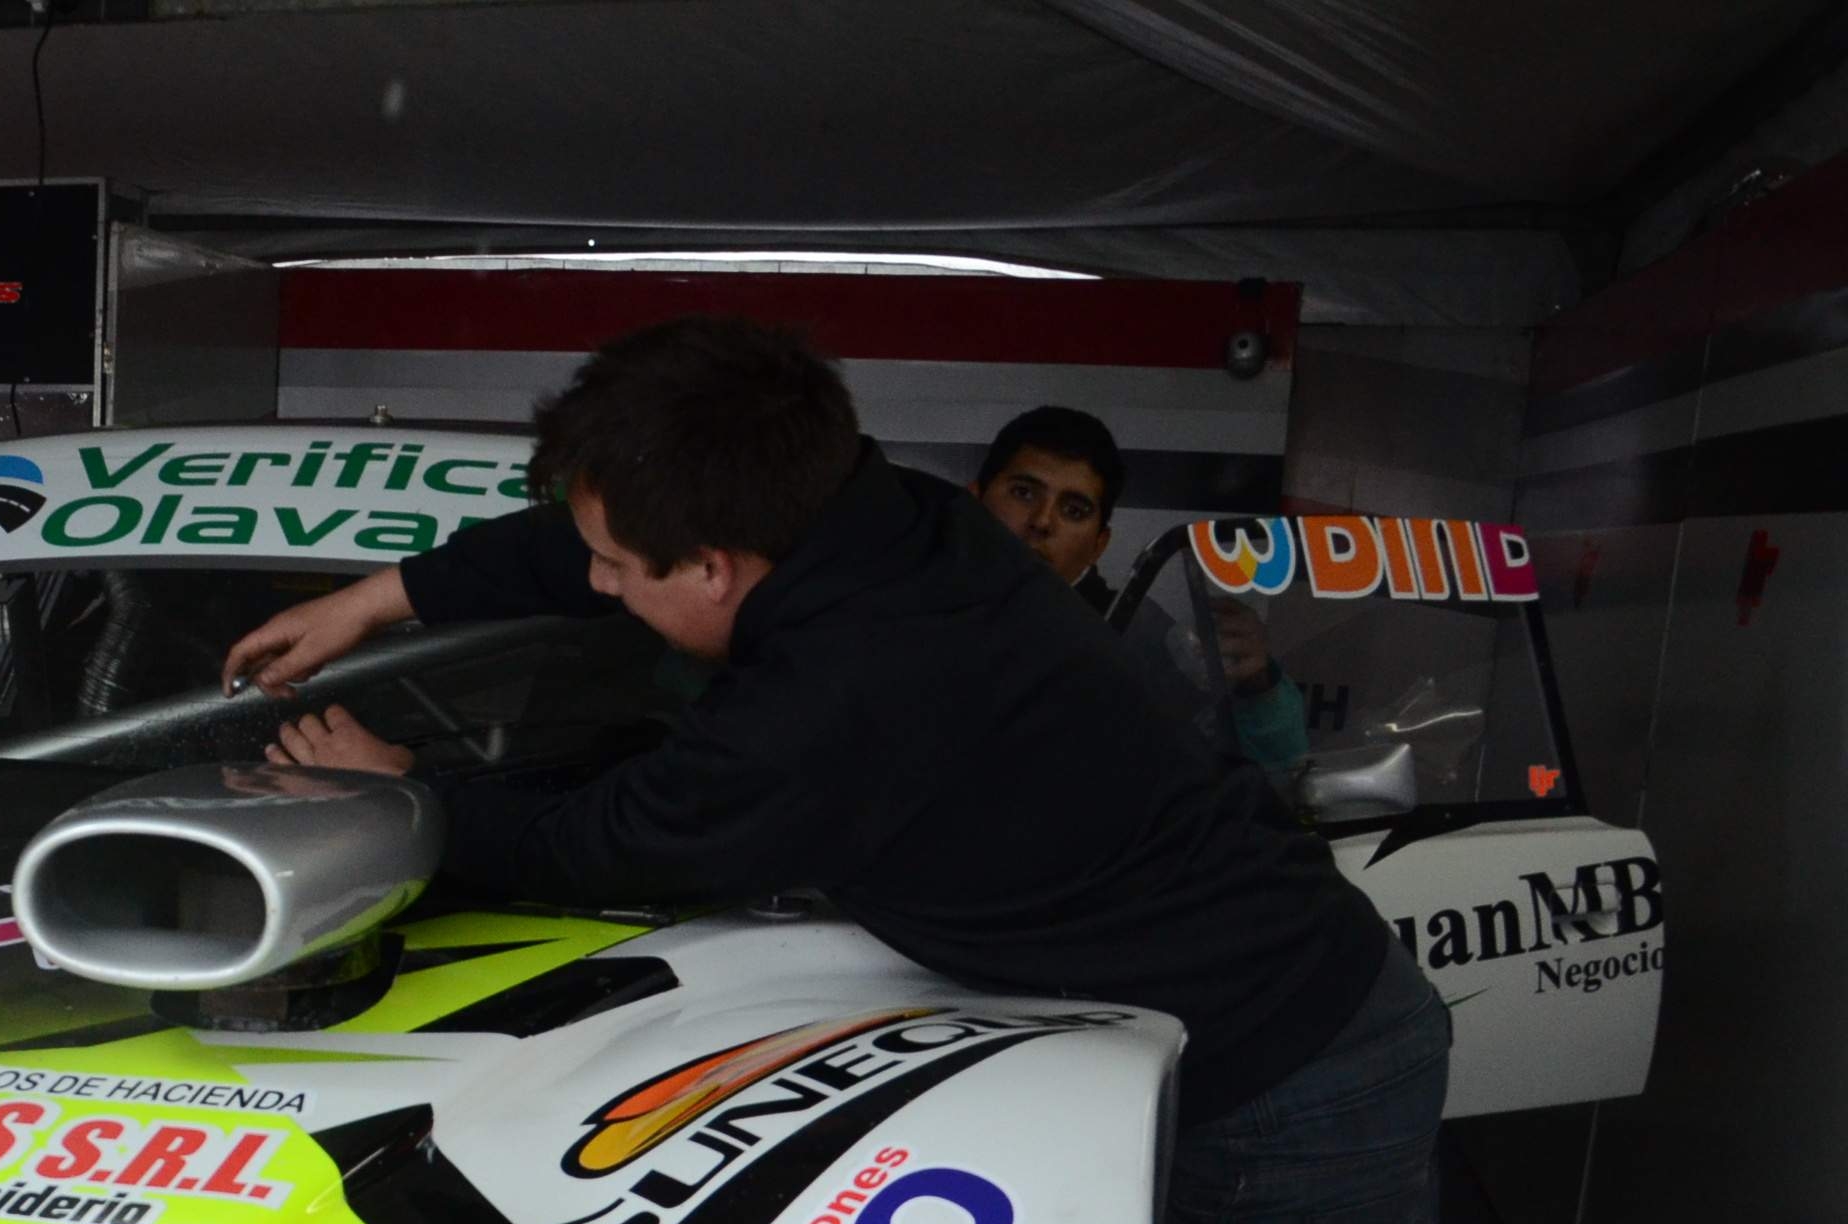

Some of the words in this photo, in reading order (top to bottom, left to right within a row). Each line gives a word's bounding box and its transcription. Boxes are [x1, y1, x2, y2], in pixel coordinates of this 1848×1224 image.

[44, 1073, 106, 1101] DE
[112, 1077, 307, 1115] HACIENDA
[38, 1118, 284, 1199] S.R.L.
